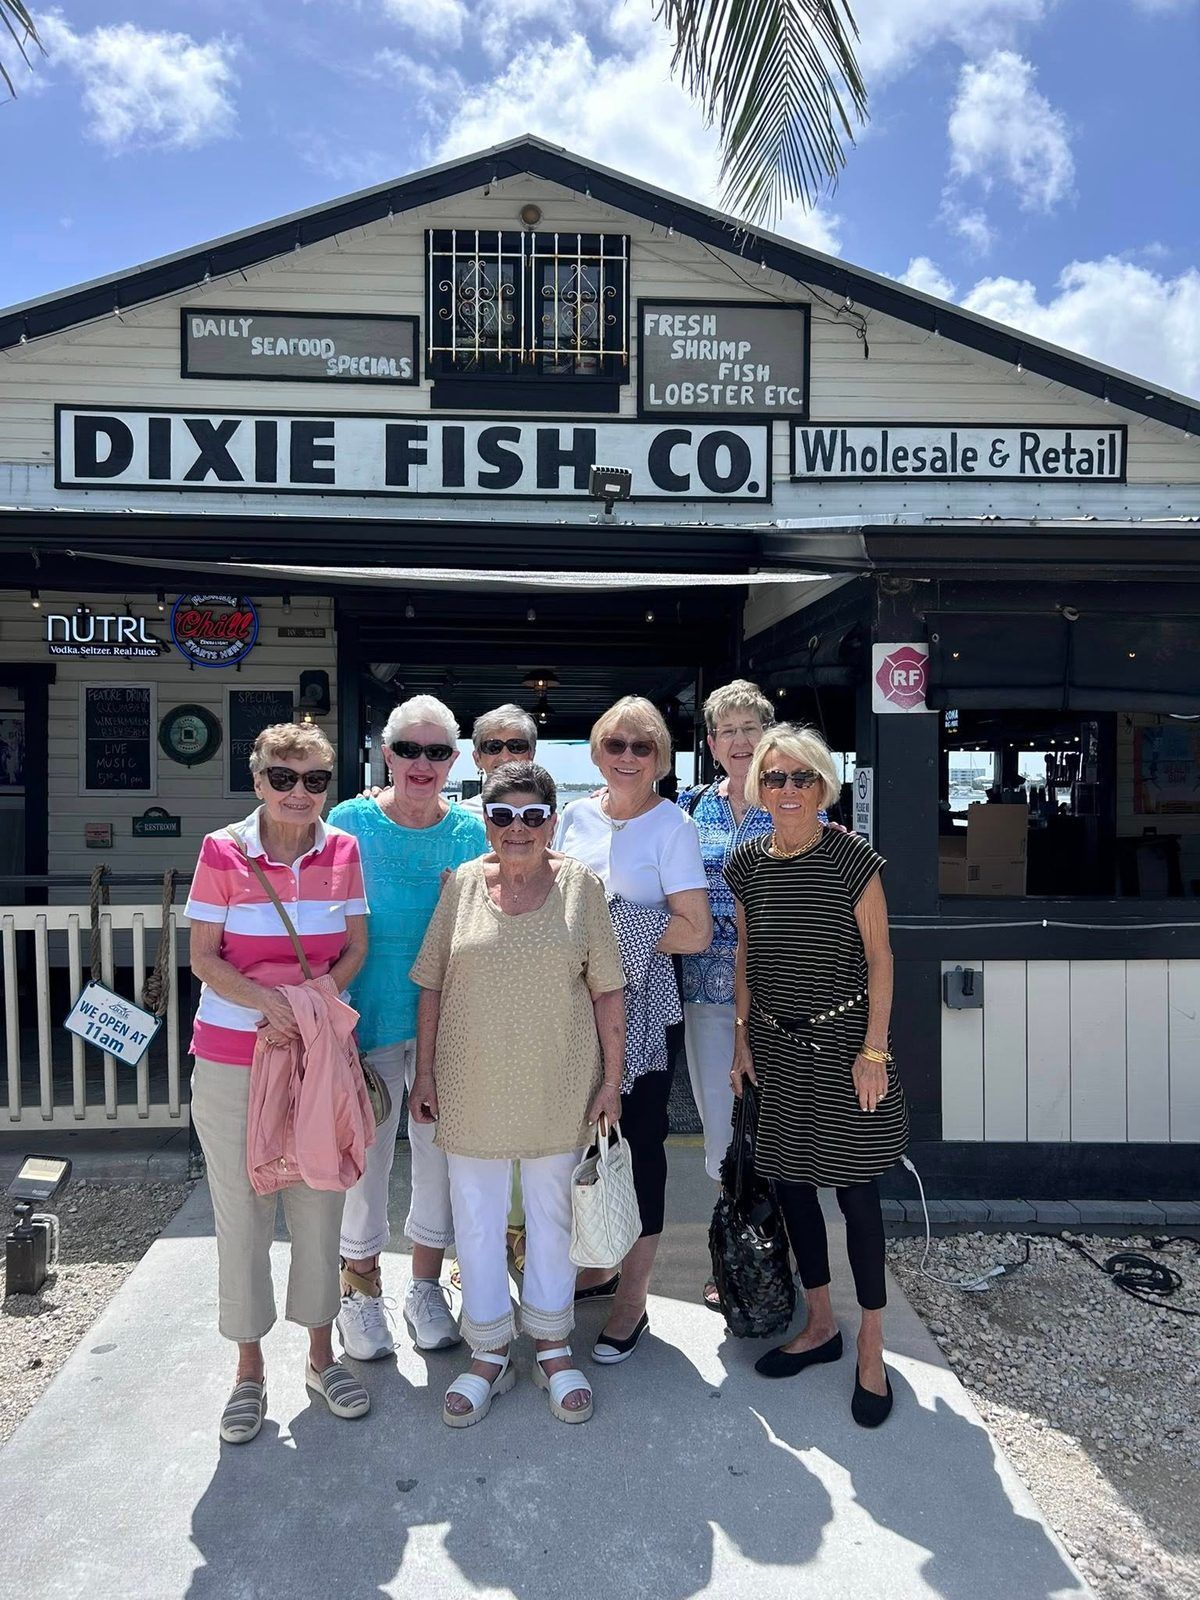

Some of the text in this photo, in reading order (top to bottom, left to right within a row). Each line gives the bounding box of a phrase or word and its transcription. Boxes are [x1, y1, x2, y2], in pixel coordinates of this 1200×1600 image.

[192, 318, 253, 338] DAILY
[644, 314, 717, 336] FRESH
[251, 337, 336, 359] SEAFOOD
[670, 339, 751, 360] SHRIMP
[326, 355, 412, 378] SPECIALS
[718, 362, 770, 382] FISH
[650, 382, 803, 406] LOBSTER ETC.
[74, 415, 760, 494] DIXIE FISH CO.
[800, 429, 1116, 475] Wholesale & Retail
[176, 609, 254, 640] Chill
[50, 646, 80, 654] Vodka.
[80, 646, 112, 655] Seltzer.
[133, 647, 158, 656] Juice.
[185, 639, 244, 660] STARTS HERE
[893, 670, 920, 686] RF
[105, 743, 128, 754] LIVE
[232, 742, 255, 755] FRES
[96, 758, 137, 768] MUSIC
[144, 822, 177, 832] RESTROOM
[80, 1000, 148, 1046] WE OPEN AT
[86, 1022, 124, 1054] 11am
